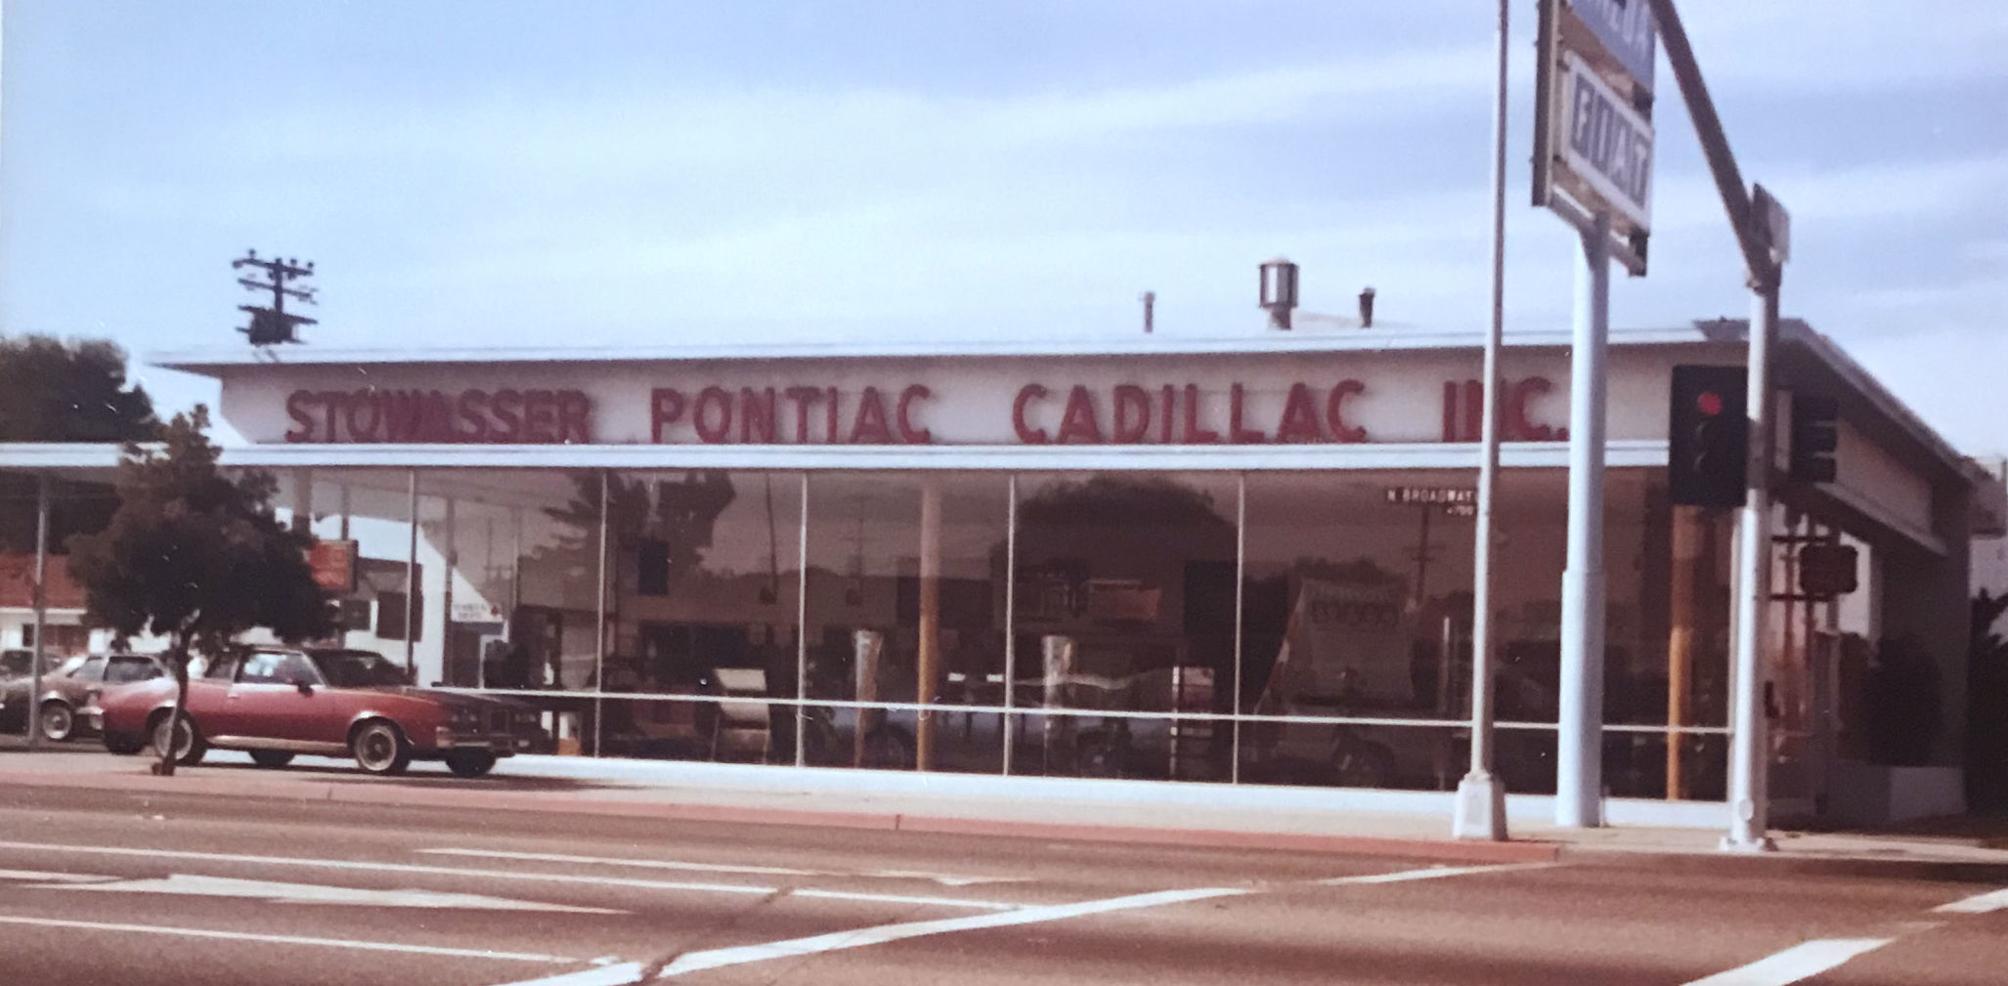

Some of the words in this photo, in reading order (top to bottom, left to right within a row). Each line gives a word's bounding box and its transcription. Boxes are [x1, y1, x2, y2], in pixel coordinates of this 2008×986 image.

[1574, 83, 1649, 202] FIAT
[285, 387, 591, 443] STOWASSER
[650, 384, 931, 444] PONTIAC
[1012, 379, 1368, 444] CADILLAC
[1442, 376, 1569, 442] INC.
[1387, 489, 1396, 502] N
[1402, 488, 1473, 503] BROADWAY
